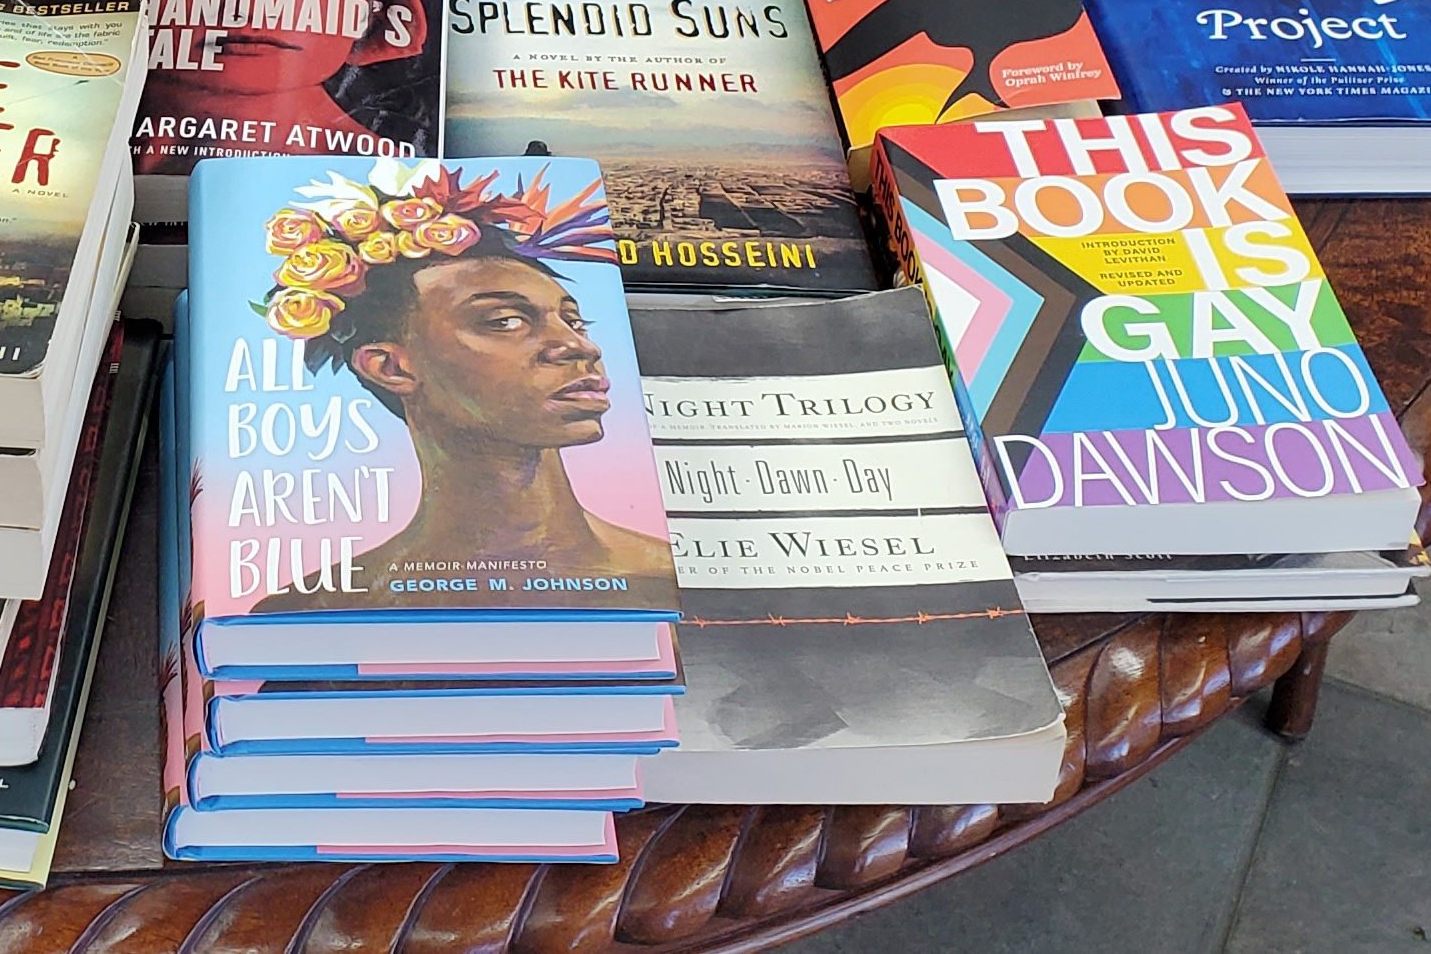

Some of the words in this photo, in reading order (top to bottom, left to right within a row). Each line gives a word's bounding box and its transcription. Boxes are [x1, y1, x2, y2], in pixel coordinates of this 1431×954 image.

[12, 0, 130, 16] BESTSELLER
[1196, 8, 1408, 49] Project
[493, 69, 549, 89] THE
[558, 70, 619, 91] KITE
[630, 72, 758, 94] RUNNER
[1001, 64, 1065, 79] Foreword
[1067, 62, 1084, 73] by
[1005, 73, 1046, 88] Oprah
[1048, 68, 1101, 84] Winfrey
[286, 125, 416, 159] ATWOOD
[974, 106, 1253, 179] THIS
[933, 158, 1295, 241] BOOK
[654, 241, 816, 270] HOSSEINI
[1182, 221, 1311, 291] IS
[1080, 279, 1322, 362] GAY
[224, 337, 315, 392] ALL
[761, 390, 936, 417] TRILOGY
[1151, 345, 1370, 432] JUNO
[228, 396, 380, 461] BOYS
[666, 460, 741, 504] Night
[757, 460, 829, 494] Dawn
[844, 458, 894, 501] Day
[994, 413, 1408, 510] DAWSON
[228, 467, 395, 528] AREN'T
[768, 531, 936, 557] WIESEL
[228, 536, 369, 600] BLUE
[389, 578, 477, 592] GEORGE
[489, 579, 514, 591] M.
[523, 577, 627, 592] JOHNSON
